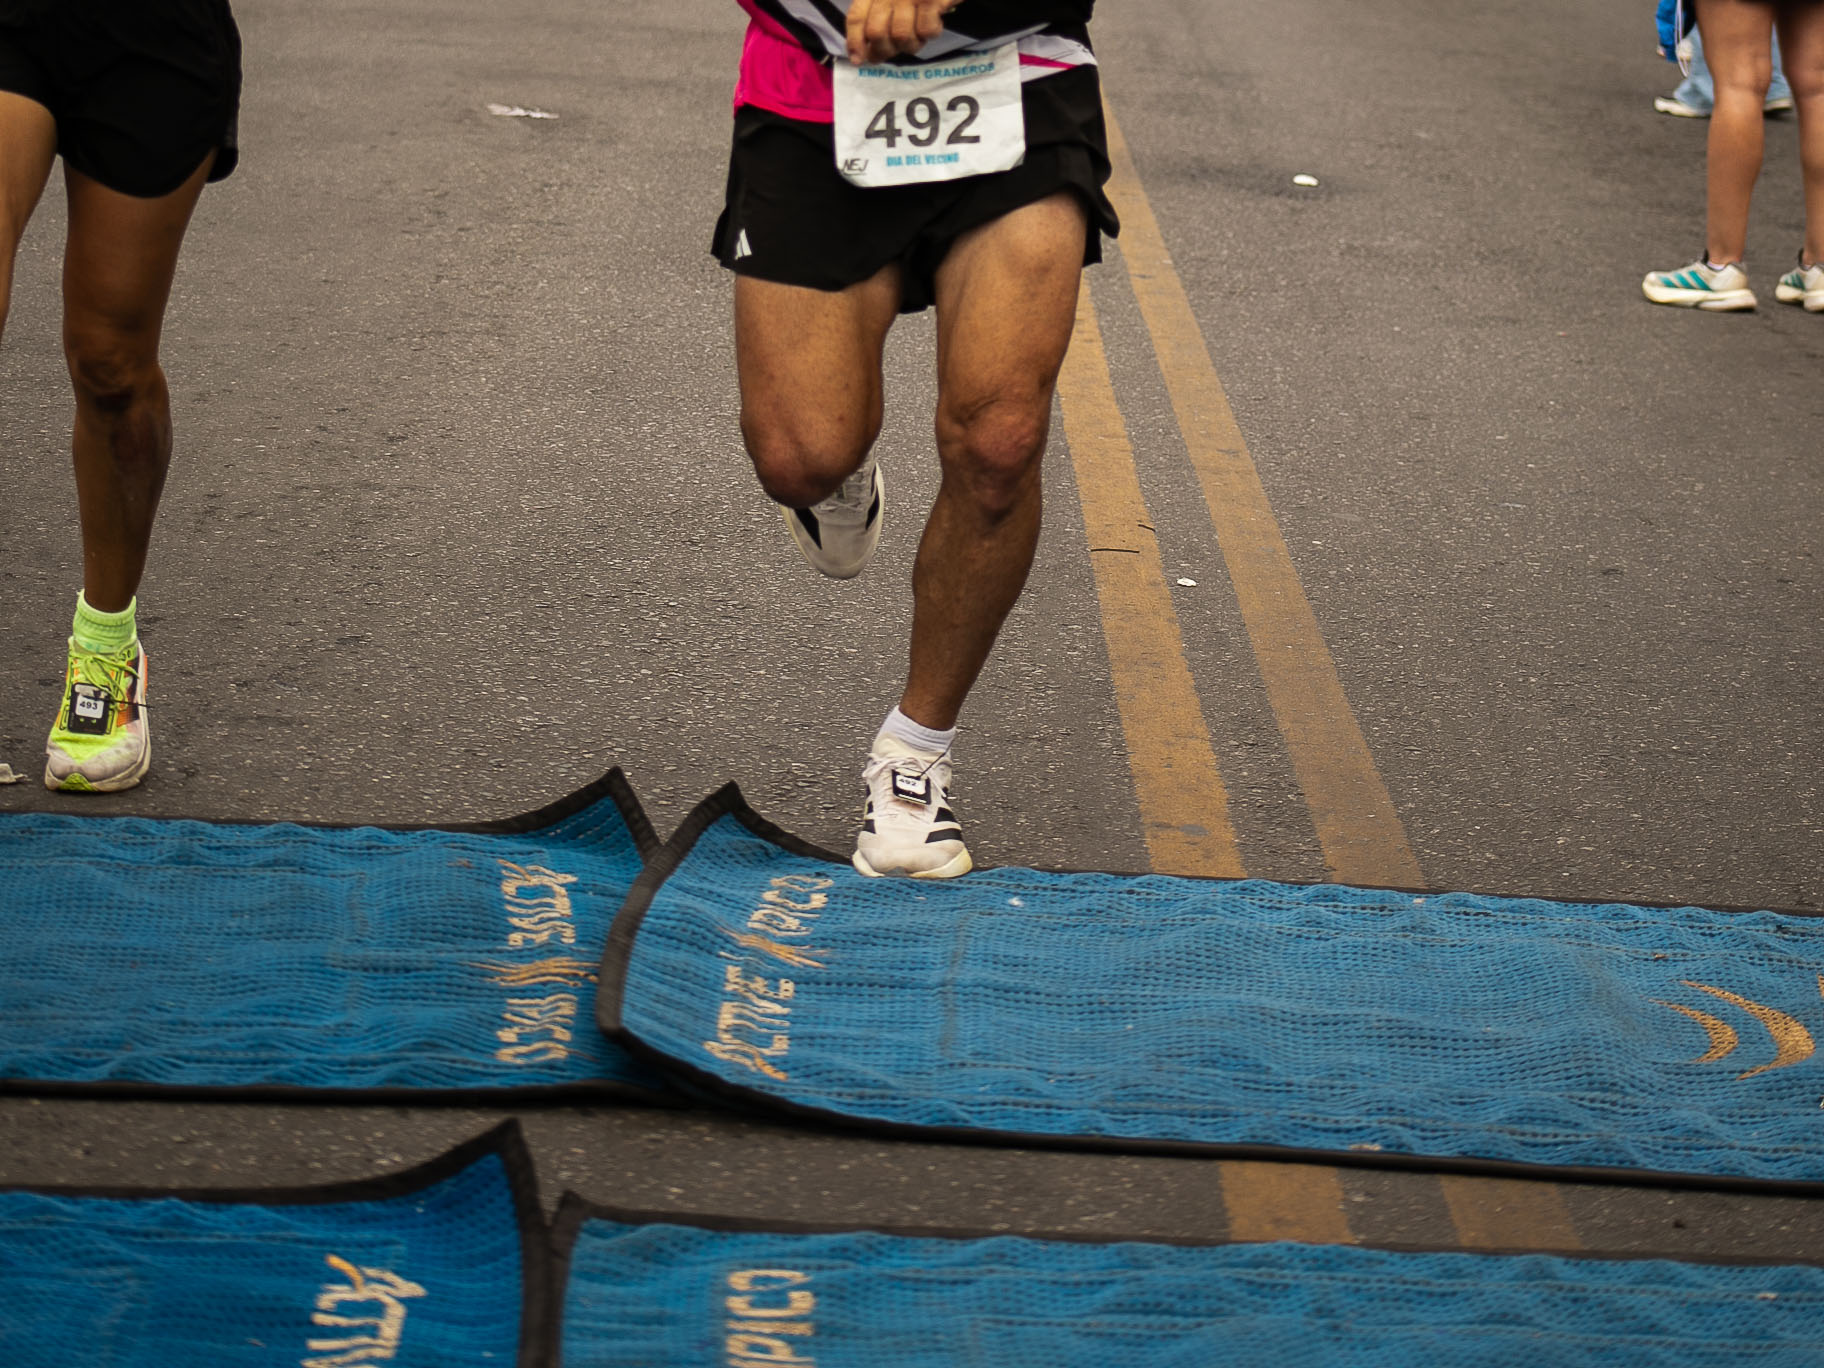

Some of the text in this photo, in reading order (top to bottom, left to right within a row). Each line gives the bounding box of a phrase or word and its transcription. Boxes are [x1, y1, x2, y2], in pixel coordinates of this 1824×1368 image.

[858, 62, 996, 80] EMPALME GRANEROS
[864, 95, 981, 148] 492
[886, 152, 960, 167] DIA DEL VECINO
[79, 699, 99, 711] 493
